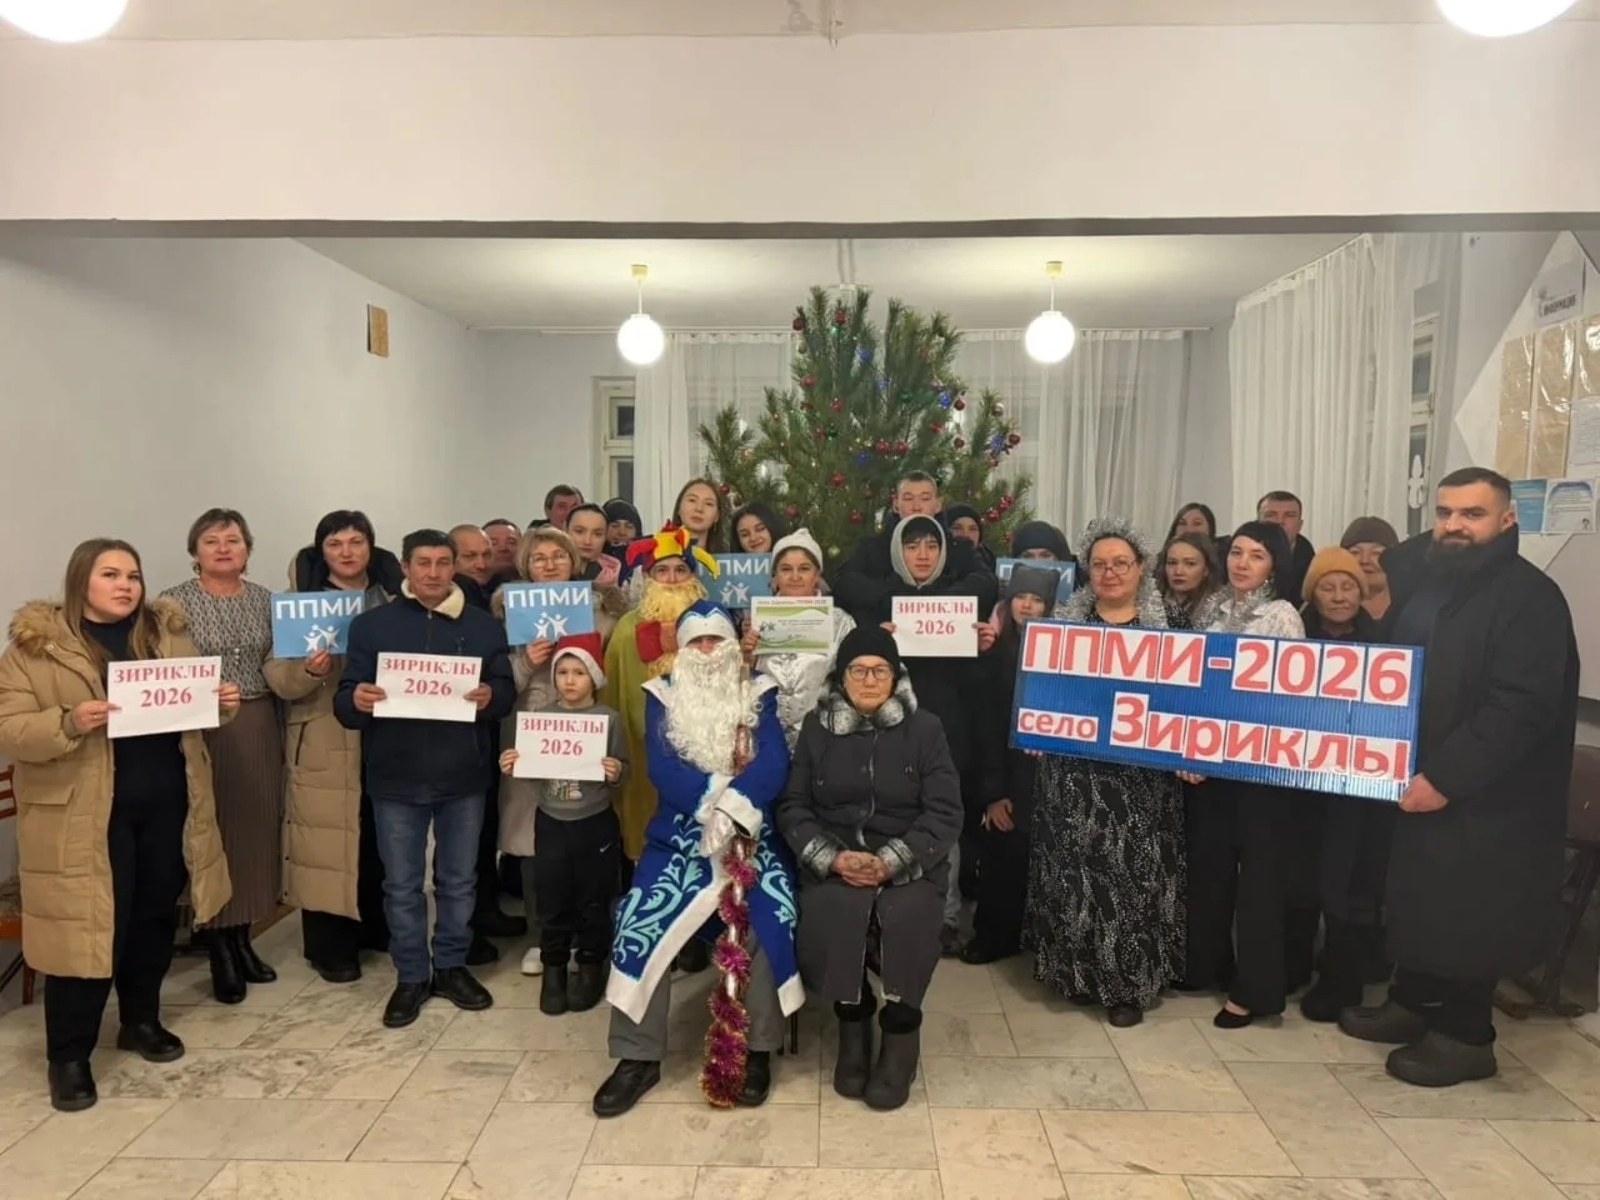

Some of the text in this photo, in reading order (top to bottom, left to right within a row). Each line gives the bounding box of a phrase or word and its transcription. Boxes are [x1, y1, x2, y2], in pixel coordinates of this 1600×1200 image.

[999, 564, 1072, 584] ПИ
[507, 587, 590, 608] ППМИ
[276, 596, 362, 620] ППМИ
[896, 602, 973, 613] ЗИРИКЛЫ
[915, 620, 955, 634] 2026
[382, 659, 476, 675] ЗИРИКЛЫ
[1024, 625, 1407, 701] ППМИ-2026
[114, 665, 216, 682] ЗИРИКЛЫ
[404, 678, 451, 695] 2026
[140, 687, 192, 707] 2026
[521, 718, 604, 733] ЗИРИКЛЫ
[540, 739, 583, 755] 2026
[1019, 697, 1408, 781] село Зириклы
